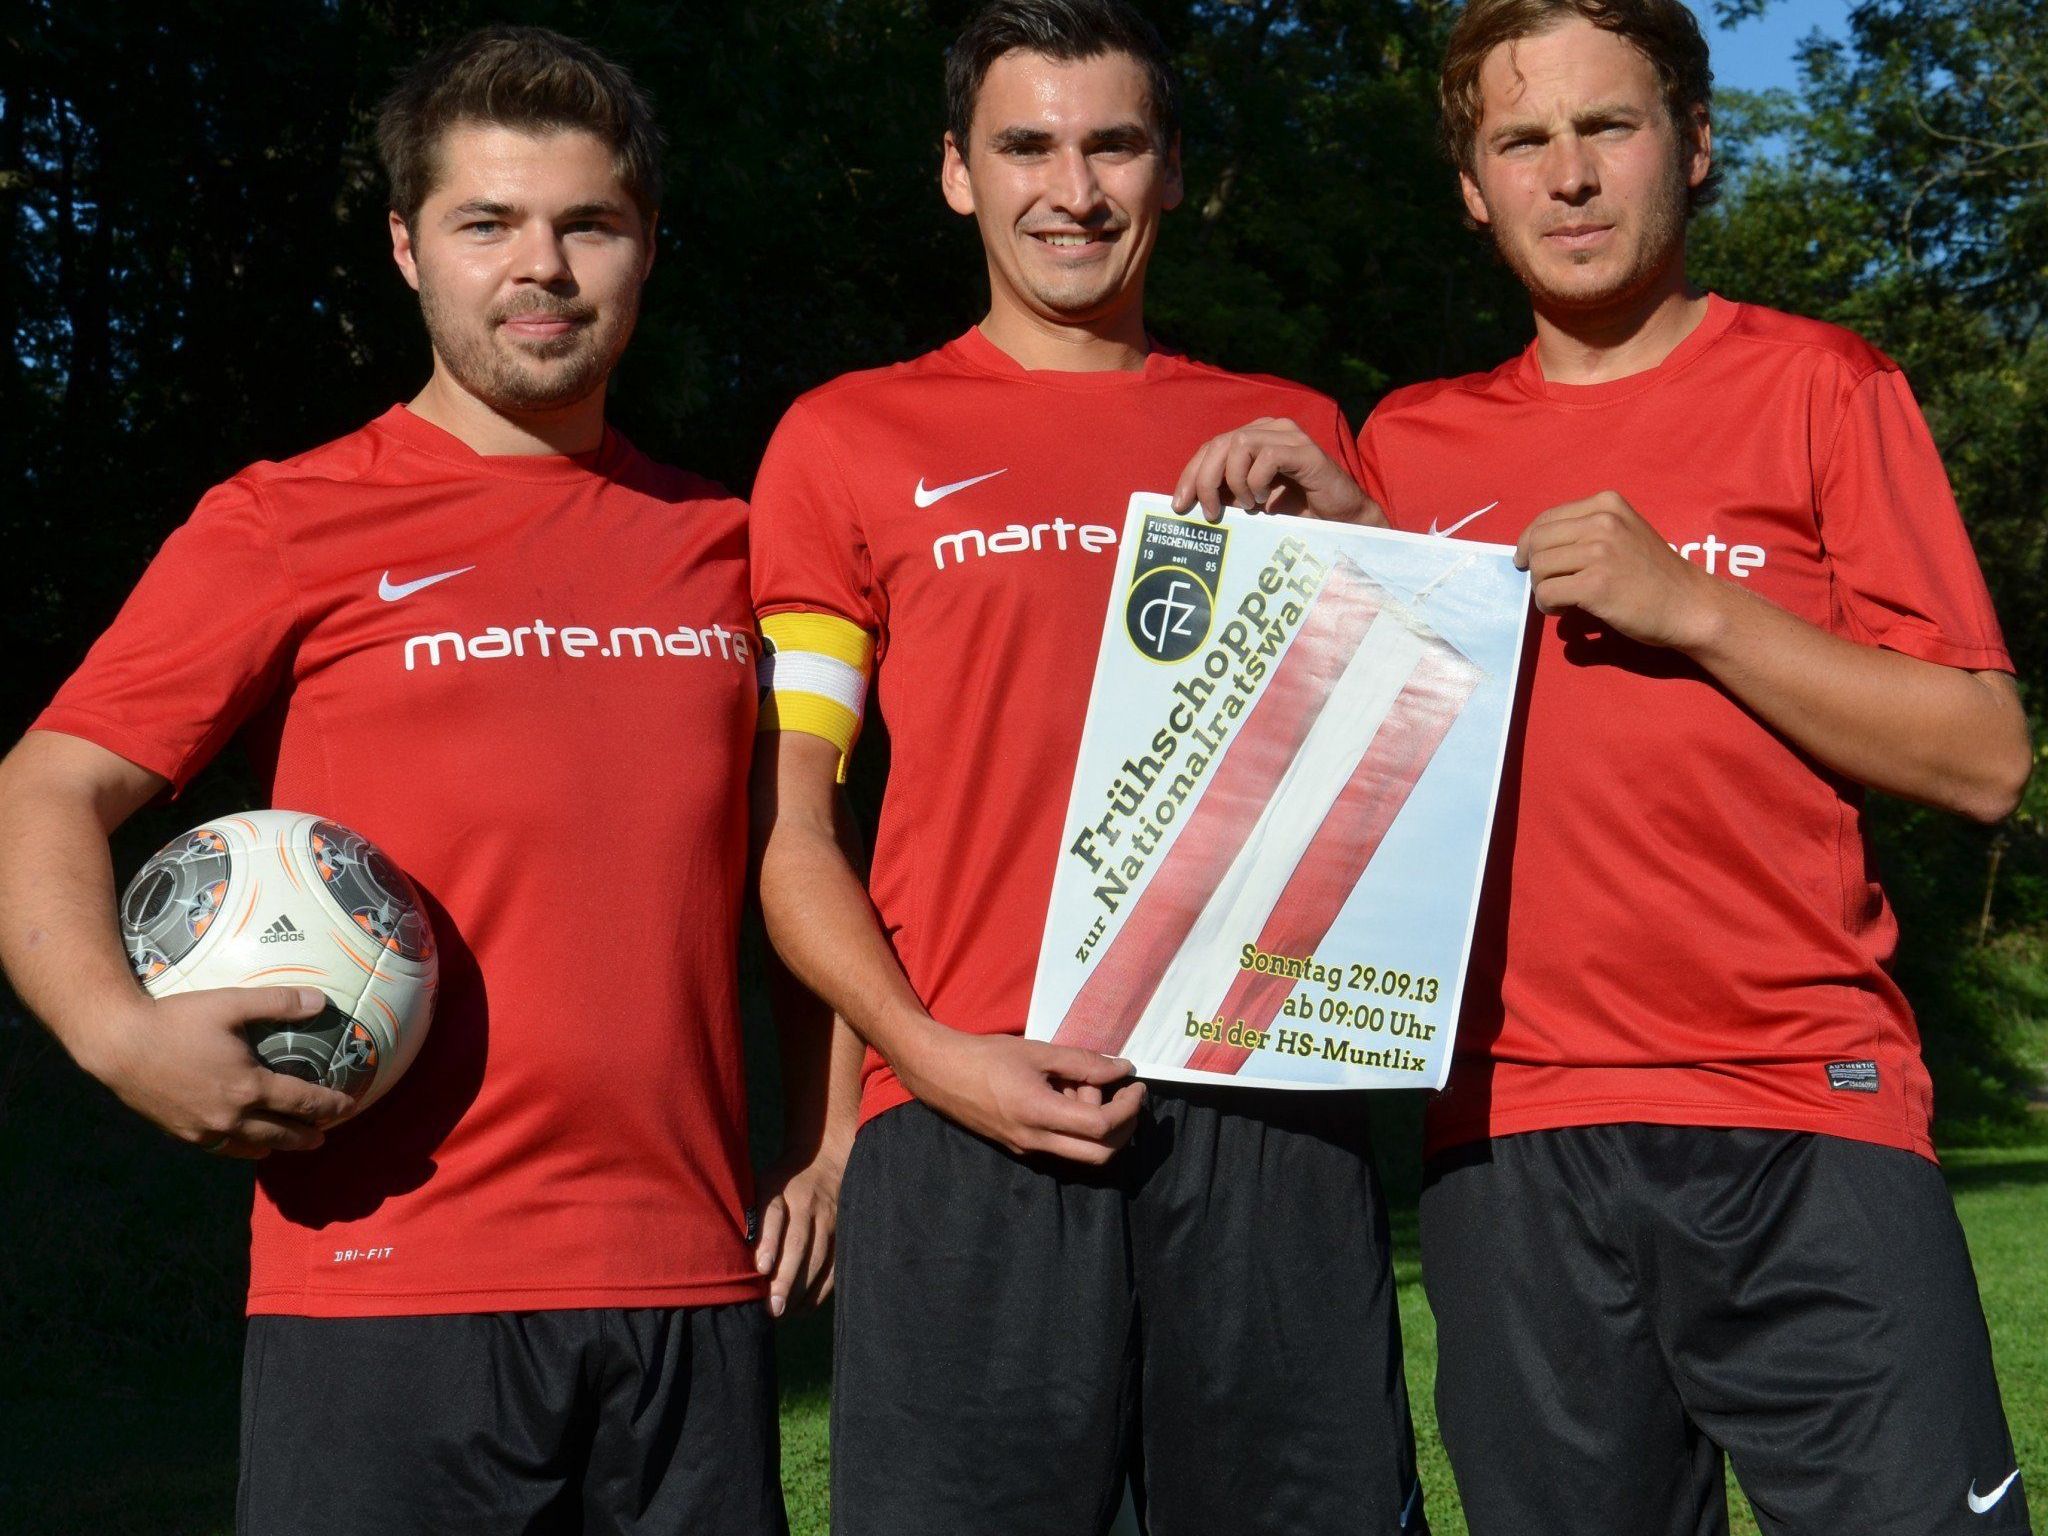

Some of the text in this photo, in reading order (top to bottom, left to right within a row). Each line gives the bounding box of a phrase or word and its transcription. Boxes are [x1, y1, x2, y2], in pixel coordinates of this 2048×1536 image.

[1145, 532, 1221, 556] ZWISCHENWASSER
[1148, 520, 1223, 544] FUSSBALLCLUB
[1143, 548, 1218, 573] 19 seit 95
[1669, 534, 1766, 578] rte
[404, 619, 751, 672] marte.marte
[1069, 535, 1306, 875] Frühschoppen
[1075, 553, 1329, 965] zur Nationalratswahl
[259, 929, 305, 945] adidas
[1239, 943, 1440, 1004] Sonntag 29.09.13
[1283, 993, 1437, 1042] ab 09:00 Uhr
[1184, 1011, 1427, 1073] bei der HS-Muntlix
[334, 1247, 394, 1262] DRI-FIT
